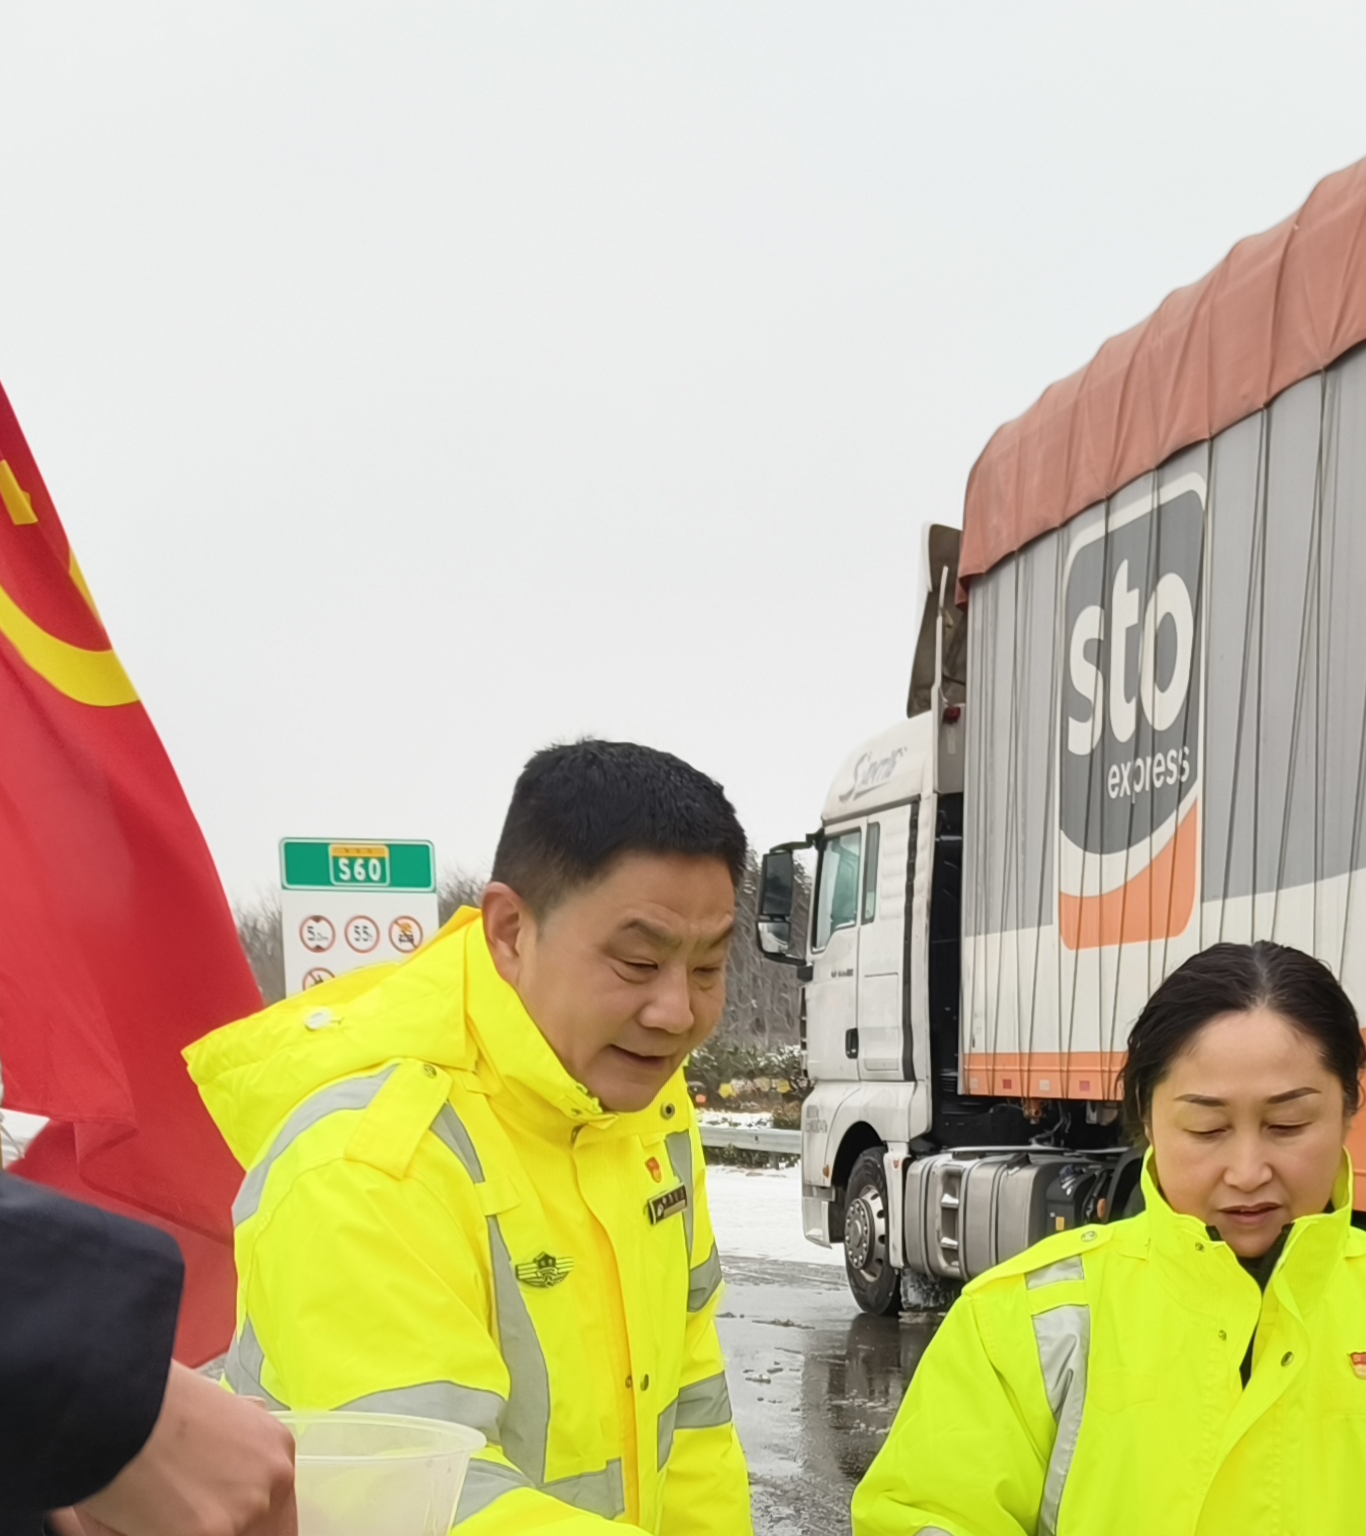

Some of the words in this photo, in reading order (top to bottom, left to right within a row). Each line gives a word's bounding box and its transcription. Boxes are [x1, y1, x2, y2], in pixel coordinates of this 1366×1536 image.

[1068, 559, 1194, 756] sto
[1108, 746, 1190, 804] express
[338, 857, 381, 881] S60
